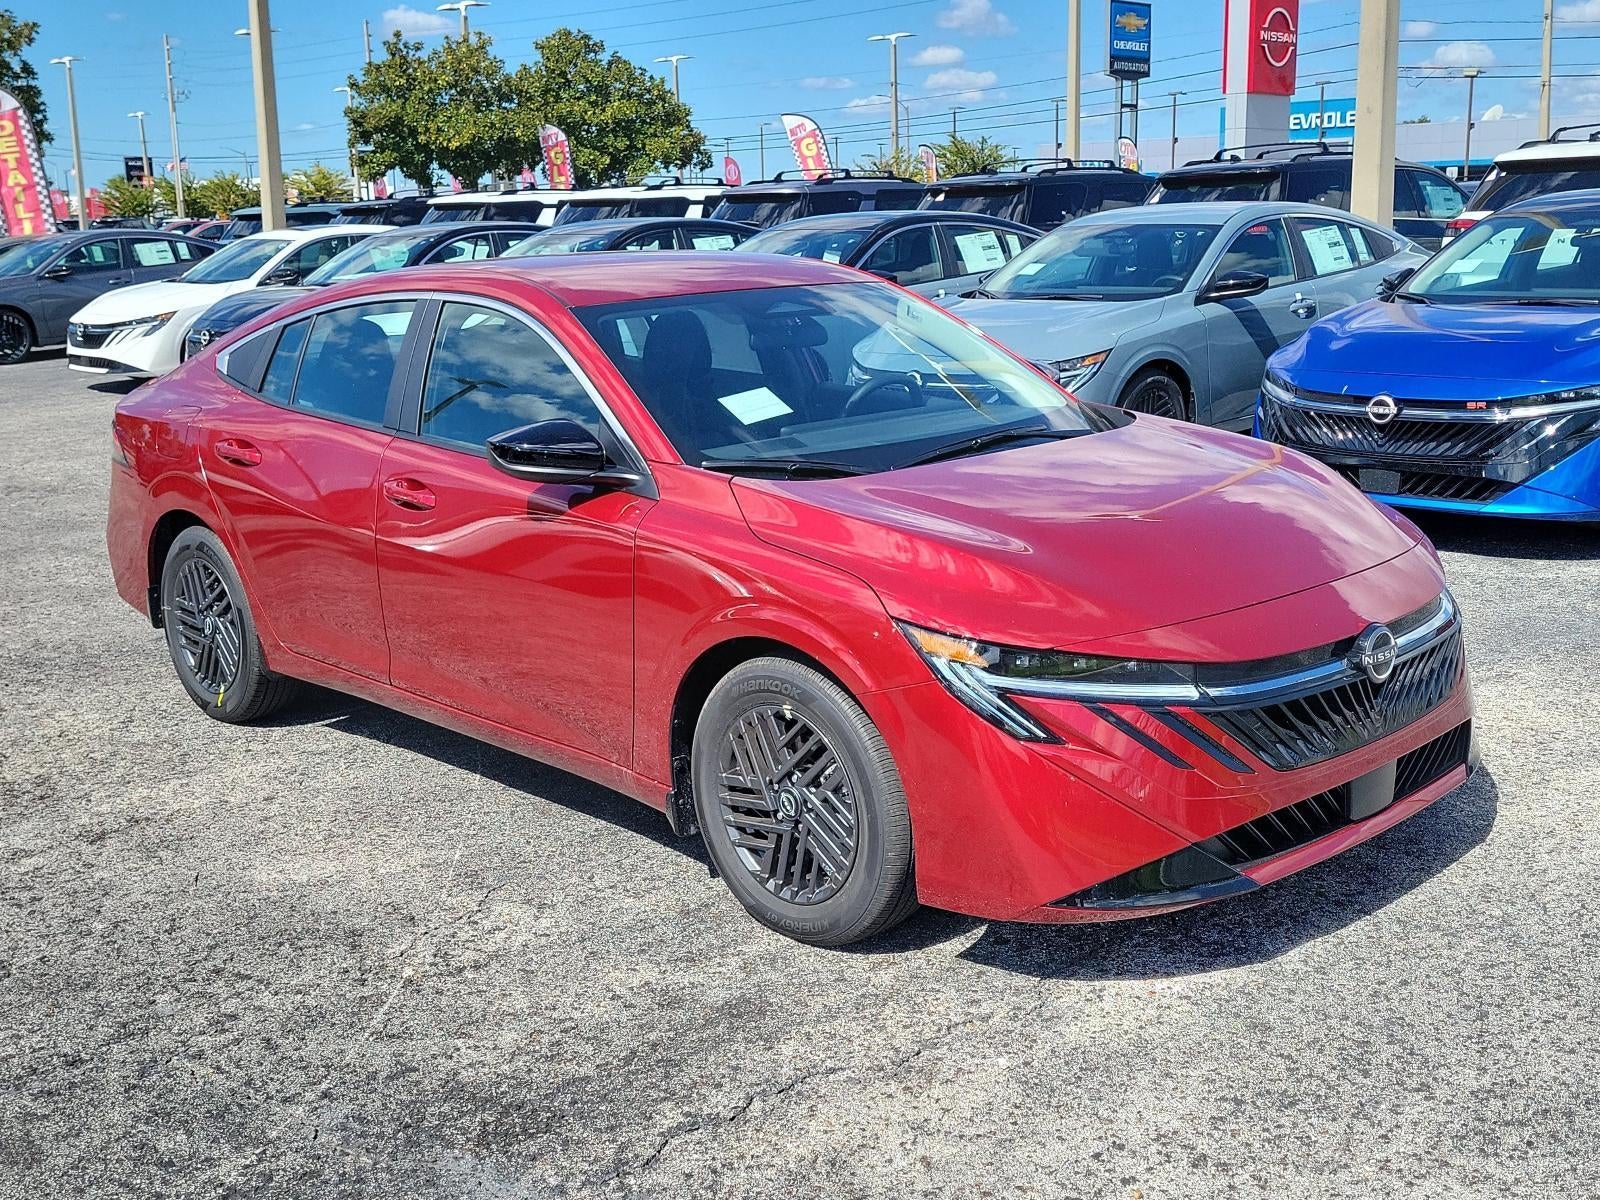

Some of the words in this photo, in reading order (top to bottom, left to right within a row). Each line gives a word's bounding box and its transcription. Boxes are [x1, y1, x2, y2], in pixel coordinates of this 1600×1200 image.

[1260, 30, 1296, 43] NISSAN
[1113, 40, 1149, 51] CHEVROLET
[1113, 61, 1149, 72] AUTONATION
[1289, 110, 1356, 130] EVROLE
[1365, 405, 1398, 414] NISSAN
[1466, 401, 1486, 410] SR
